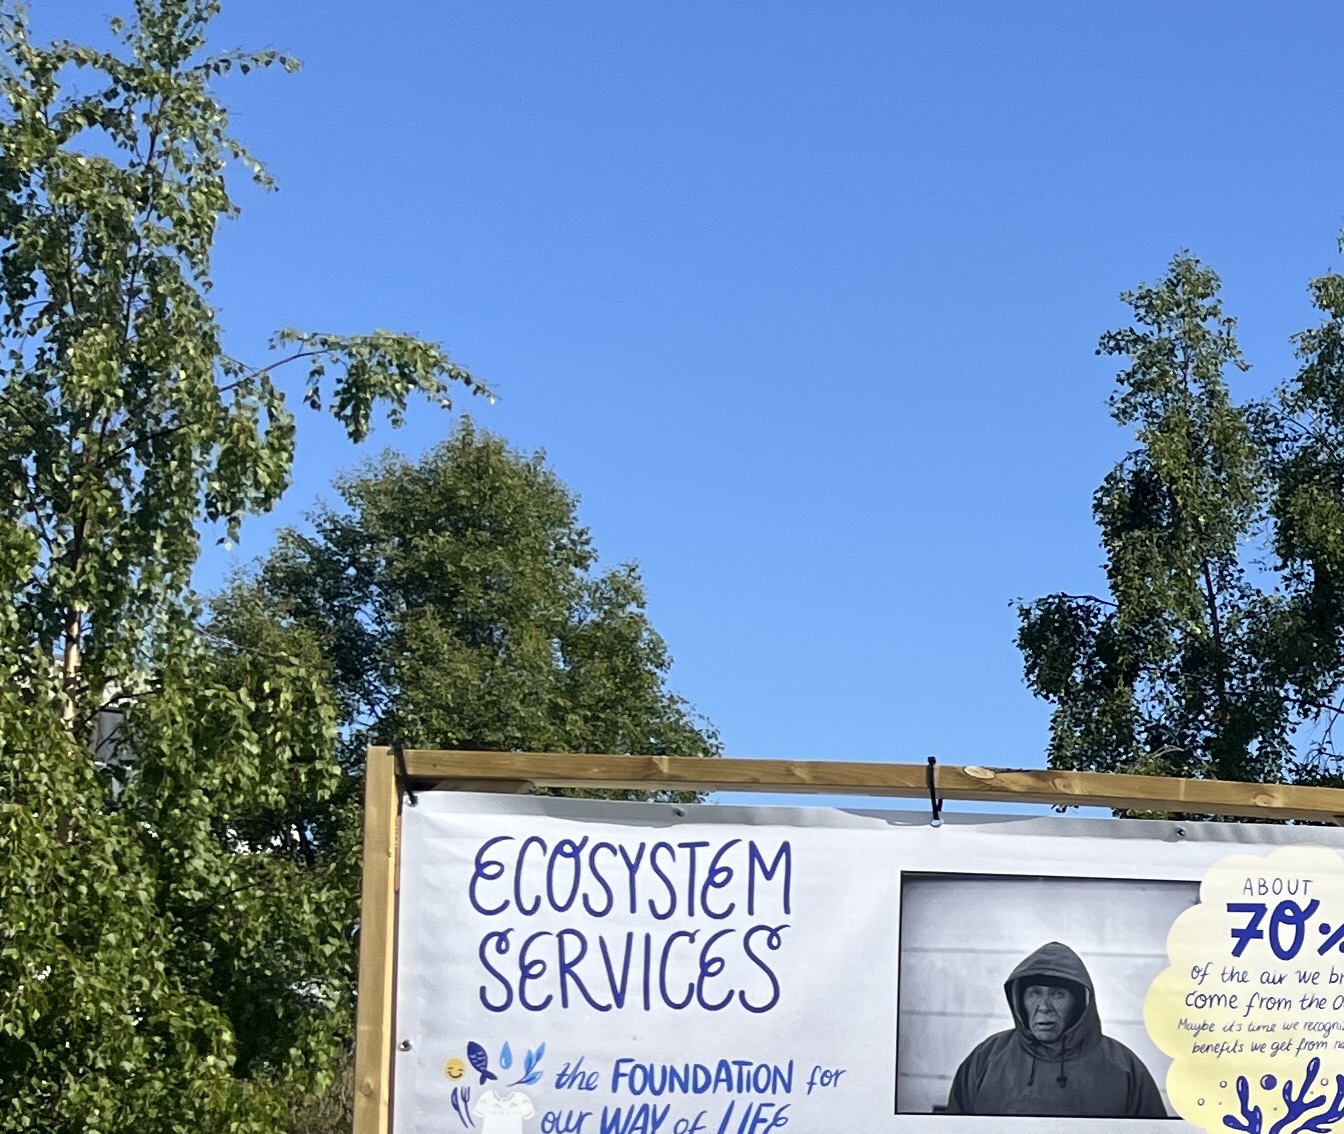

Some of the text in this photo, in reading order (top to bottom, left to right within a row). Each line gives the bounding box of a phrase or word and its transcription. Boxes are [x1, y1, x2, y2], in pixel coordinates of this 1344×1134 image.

[470, 835, 791, 920] ECOSYSTEM
[1243, 878, 1313, 896] ABOUT
[479, 925, 791, 1013] SERVICES
[1191, 962, 1213, 985] of
[1221, 966, 1249, 983] the
[1260, 970, 1287, 985] air
[1295, 970, 1320, 985] we
[1186, 991, 1238, 1009] come
[1243, 992, 1292, 1017] from
[1300, 993, 1328, 1010] the
[1178, 1019, 1215, 1037] Maybe
[1248, 1021, 1276, 1032] time
[1283, 1021, 1299, 1032] we
[1192, 1042, 1244, 1059] benefits
[1251, 1042, 1267, 1054] we
[1271, 1042, 1293, 1057] get
[1296, 1040, 1328, 1057] from
[555, 1056, 847, 1096] the FOUNDATION for
[540, 1109, 594, 1134] our
